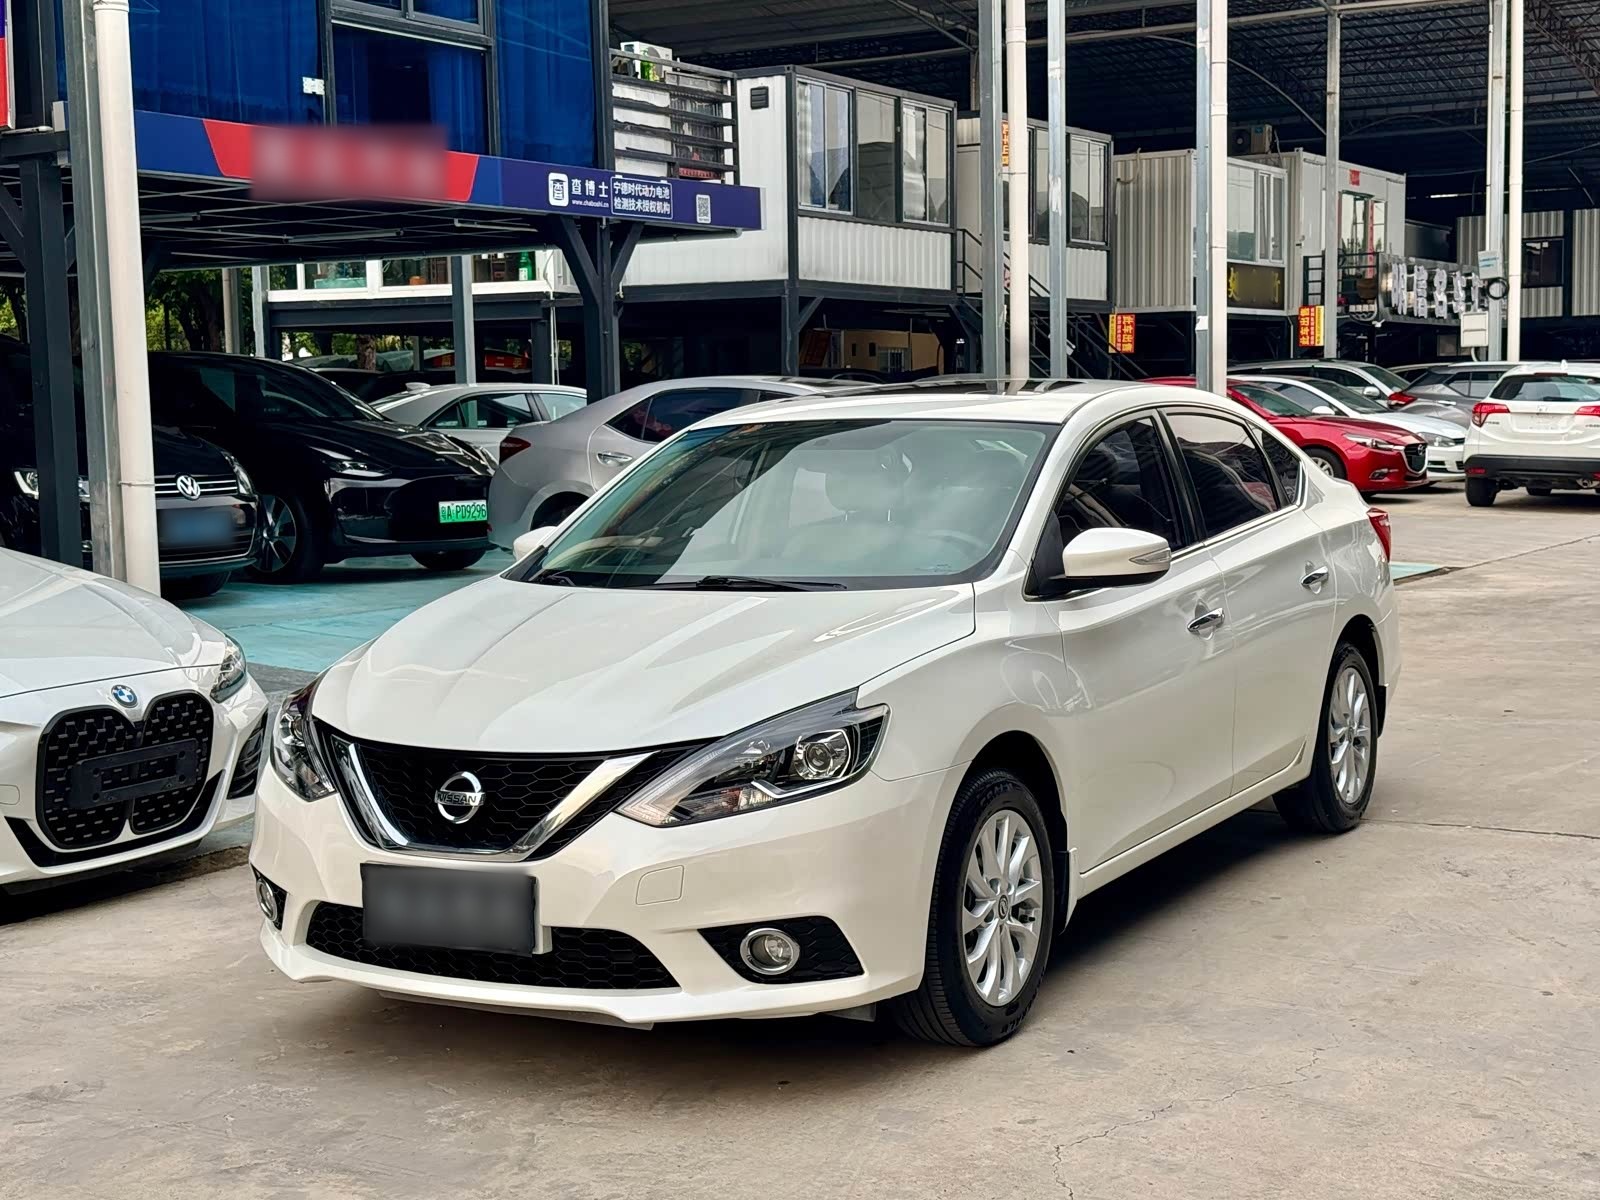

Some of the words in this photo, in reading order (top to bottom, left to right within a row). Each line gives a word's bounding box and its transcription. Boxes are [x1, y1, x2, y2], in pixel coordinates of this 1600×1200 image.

[571, 178, 609, 198] 查博士
[613, 180, 670, 199] 宁德时代动力电池
[613, 196, 671, 214] 检测技术授权机构
[1122, 314, 1134, 352] 此车出售
[1299, 307, 1310, 345] 此车出售
[436, 792, 477, 803] NISSAN
